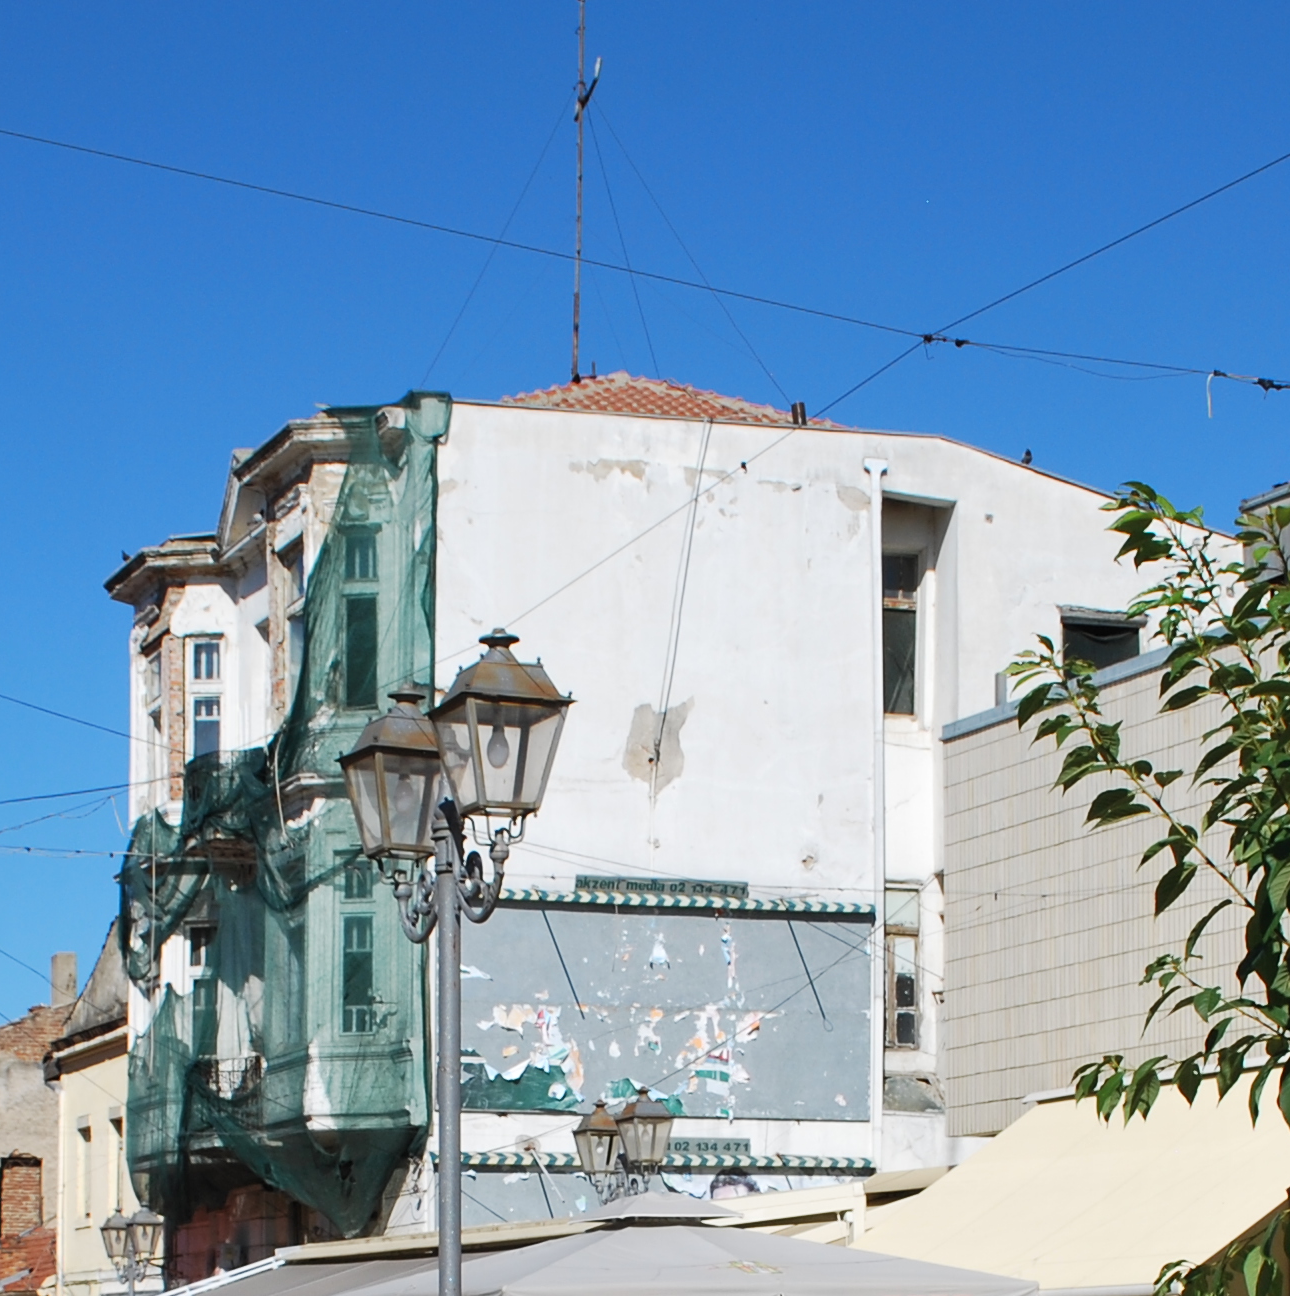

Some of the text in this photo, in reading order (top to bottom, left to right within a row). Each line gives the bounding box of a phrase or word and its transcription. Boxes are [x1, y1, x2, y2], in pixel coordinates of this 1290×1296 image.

[575, 876, 620, 890] akzent
[626, 880, 665, 892] media
[719, 885, 747, 896] 471
[674, 1141, 690, 1151] 02
[695, 1142, 718, 1152] 134
[723, 1142, 749, 1152] 471
